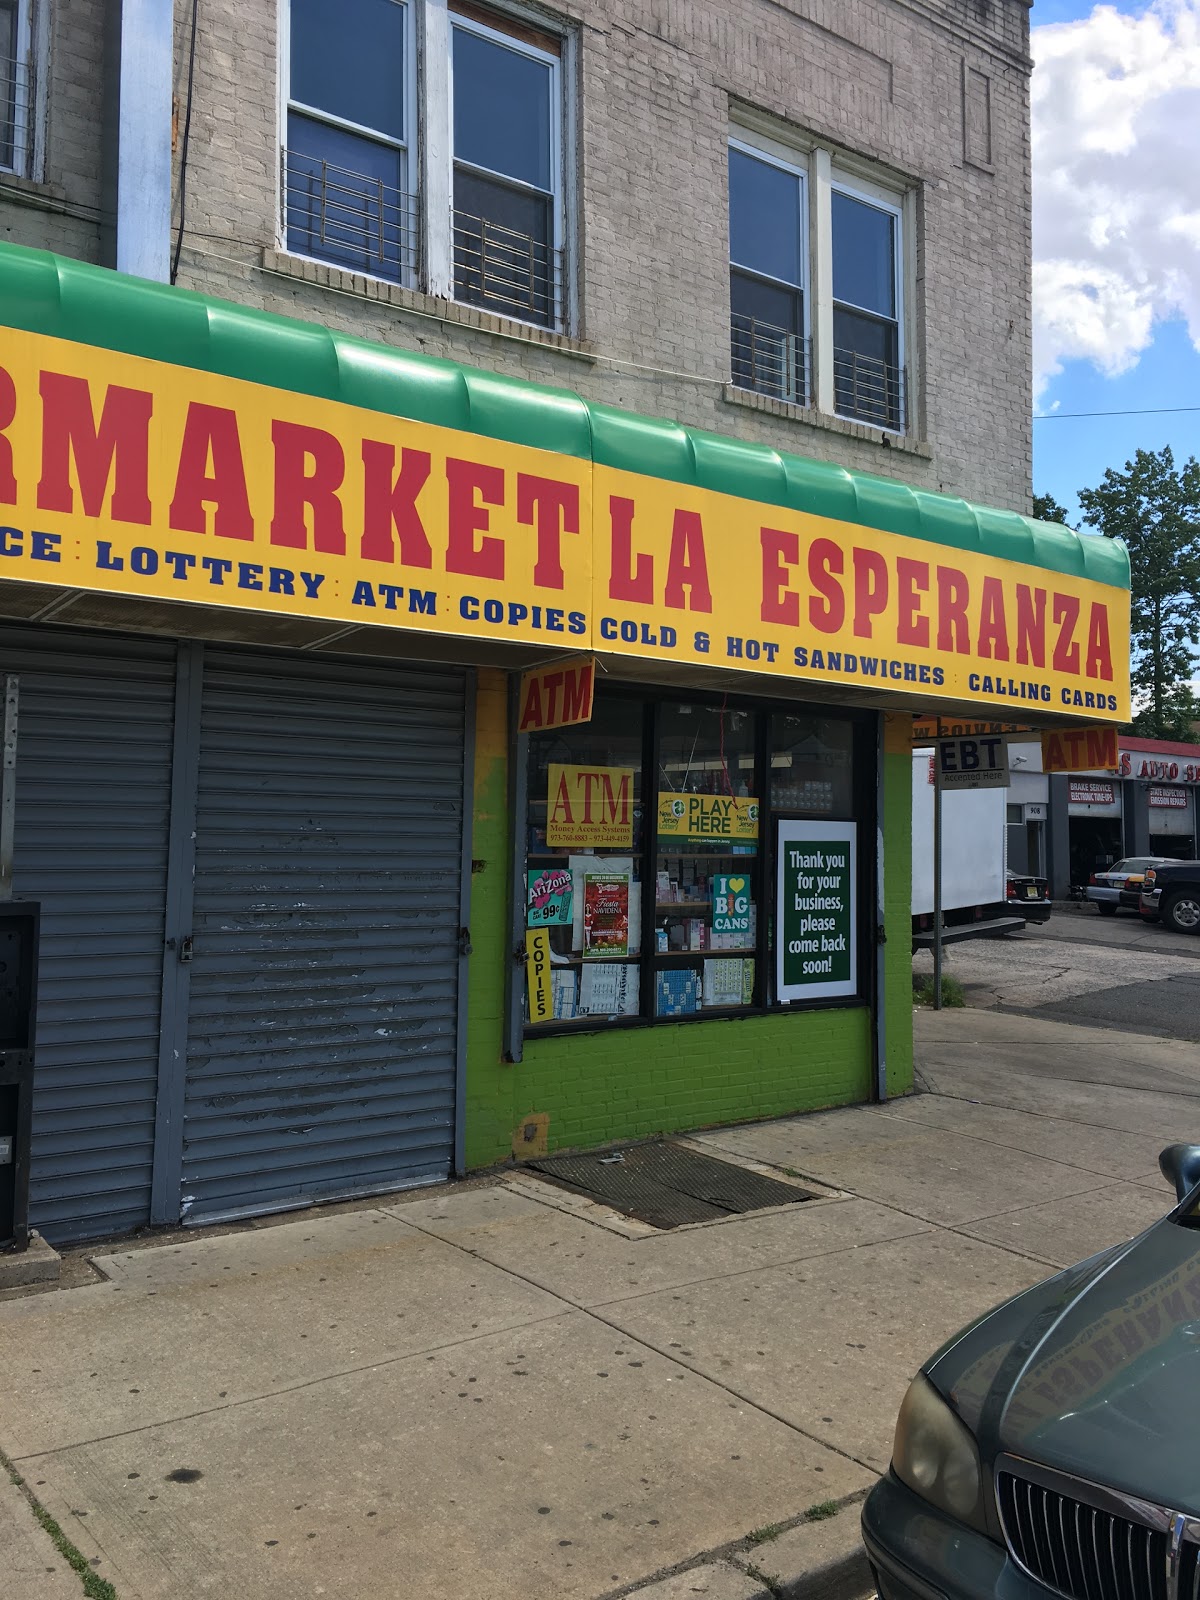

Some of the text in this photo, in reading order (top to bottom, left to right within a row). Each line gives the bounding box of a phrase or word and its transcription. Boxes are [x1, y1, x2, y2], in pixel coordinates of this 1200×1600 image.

[0, 365, 1114, 682] MARKET LA ESPERANZA
[96, 540, 326, 599] LOTTERY
[351, 580, 437, 615] ATM
[459, 595, 587, 635] COPIES
[600, 617, 677, 648] COLD
[694, 631, 710, 653] &
[726, 636, 780, 663] HOT
[793, 646, 945, 686] SANDWICHES
[968, 673, 1052, 703] CALLING
[1060, 687, 1118, 712] CARDS
[520, 665, 592, 730] ATM
[940, 738, 1002, 770] EBT
[1045, 729, 1116, 769] ATM
[944, 771, 1003, 783] Accepted Here
[1140, 760, 1179, 780] AUTO
[1070, 783, 1111, 792] BRAKE SERVICE
[550, 770, 631, 825] ATM
[689, 798, 732, 816] PLAY
[1030, 807, 1041, 815] 908
[550, 825, 574, 834] Money
[602, 826, 630, 834] Systems
[659, 823, 678, 831] Lottery
[689, 816, 731, 833] HERE
[789, 850, 845, 873] Thank you
[720, 878, 727, 895] I
[797, 871, 841, 893] for your
[595, 897, 619, 908] Fiesta
[794, 893, 844, 912] business,
[715, 917, 748, 930] CANS
[800, 914, 836, 936] please
[788, 933, 846, 954] come back
[802, 955, 832, 974] soon!
[533, 936, 546, 1016] COPIES
